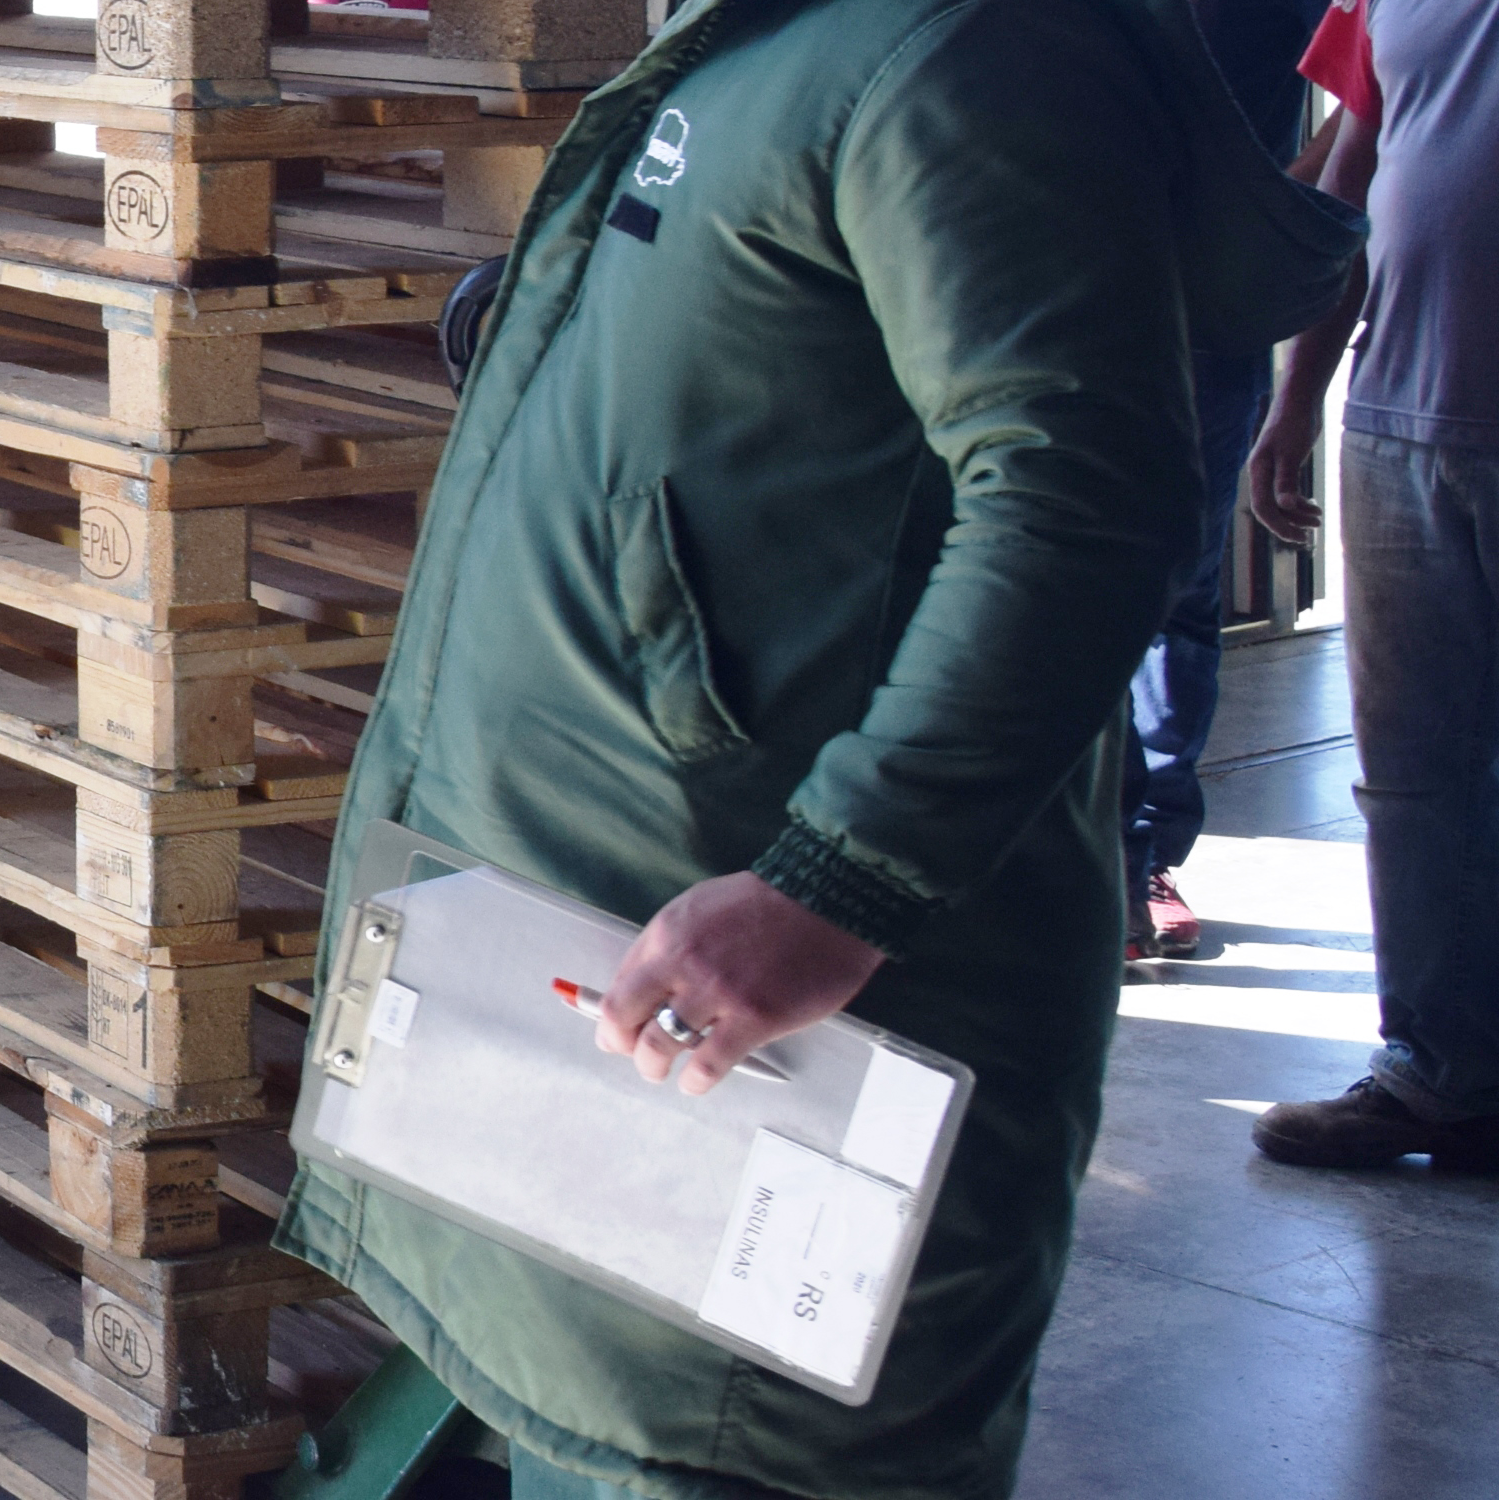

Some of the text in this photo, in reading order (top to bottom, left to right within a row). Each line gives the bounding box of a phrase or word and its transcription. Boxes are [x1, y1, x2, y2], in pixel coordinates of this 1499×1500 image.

[107, 14, 152, 53] EPAL
[117, 185, 160, 229] EPAL
[731, 1185, 775, 1281] INSULINAS
[793, 1281, 825, 1323] RS
[101, 1309, 144, 1371] EPAL
